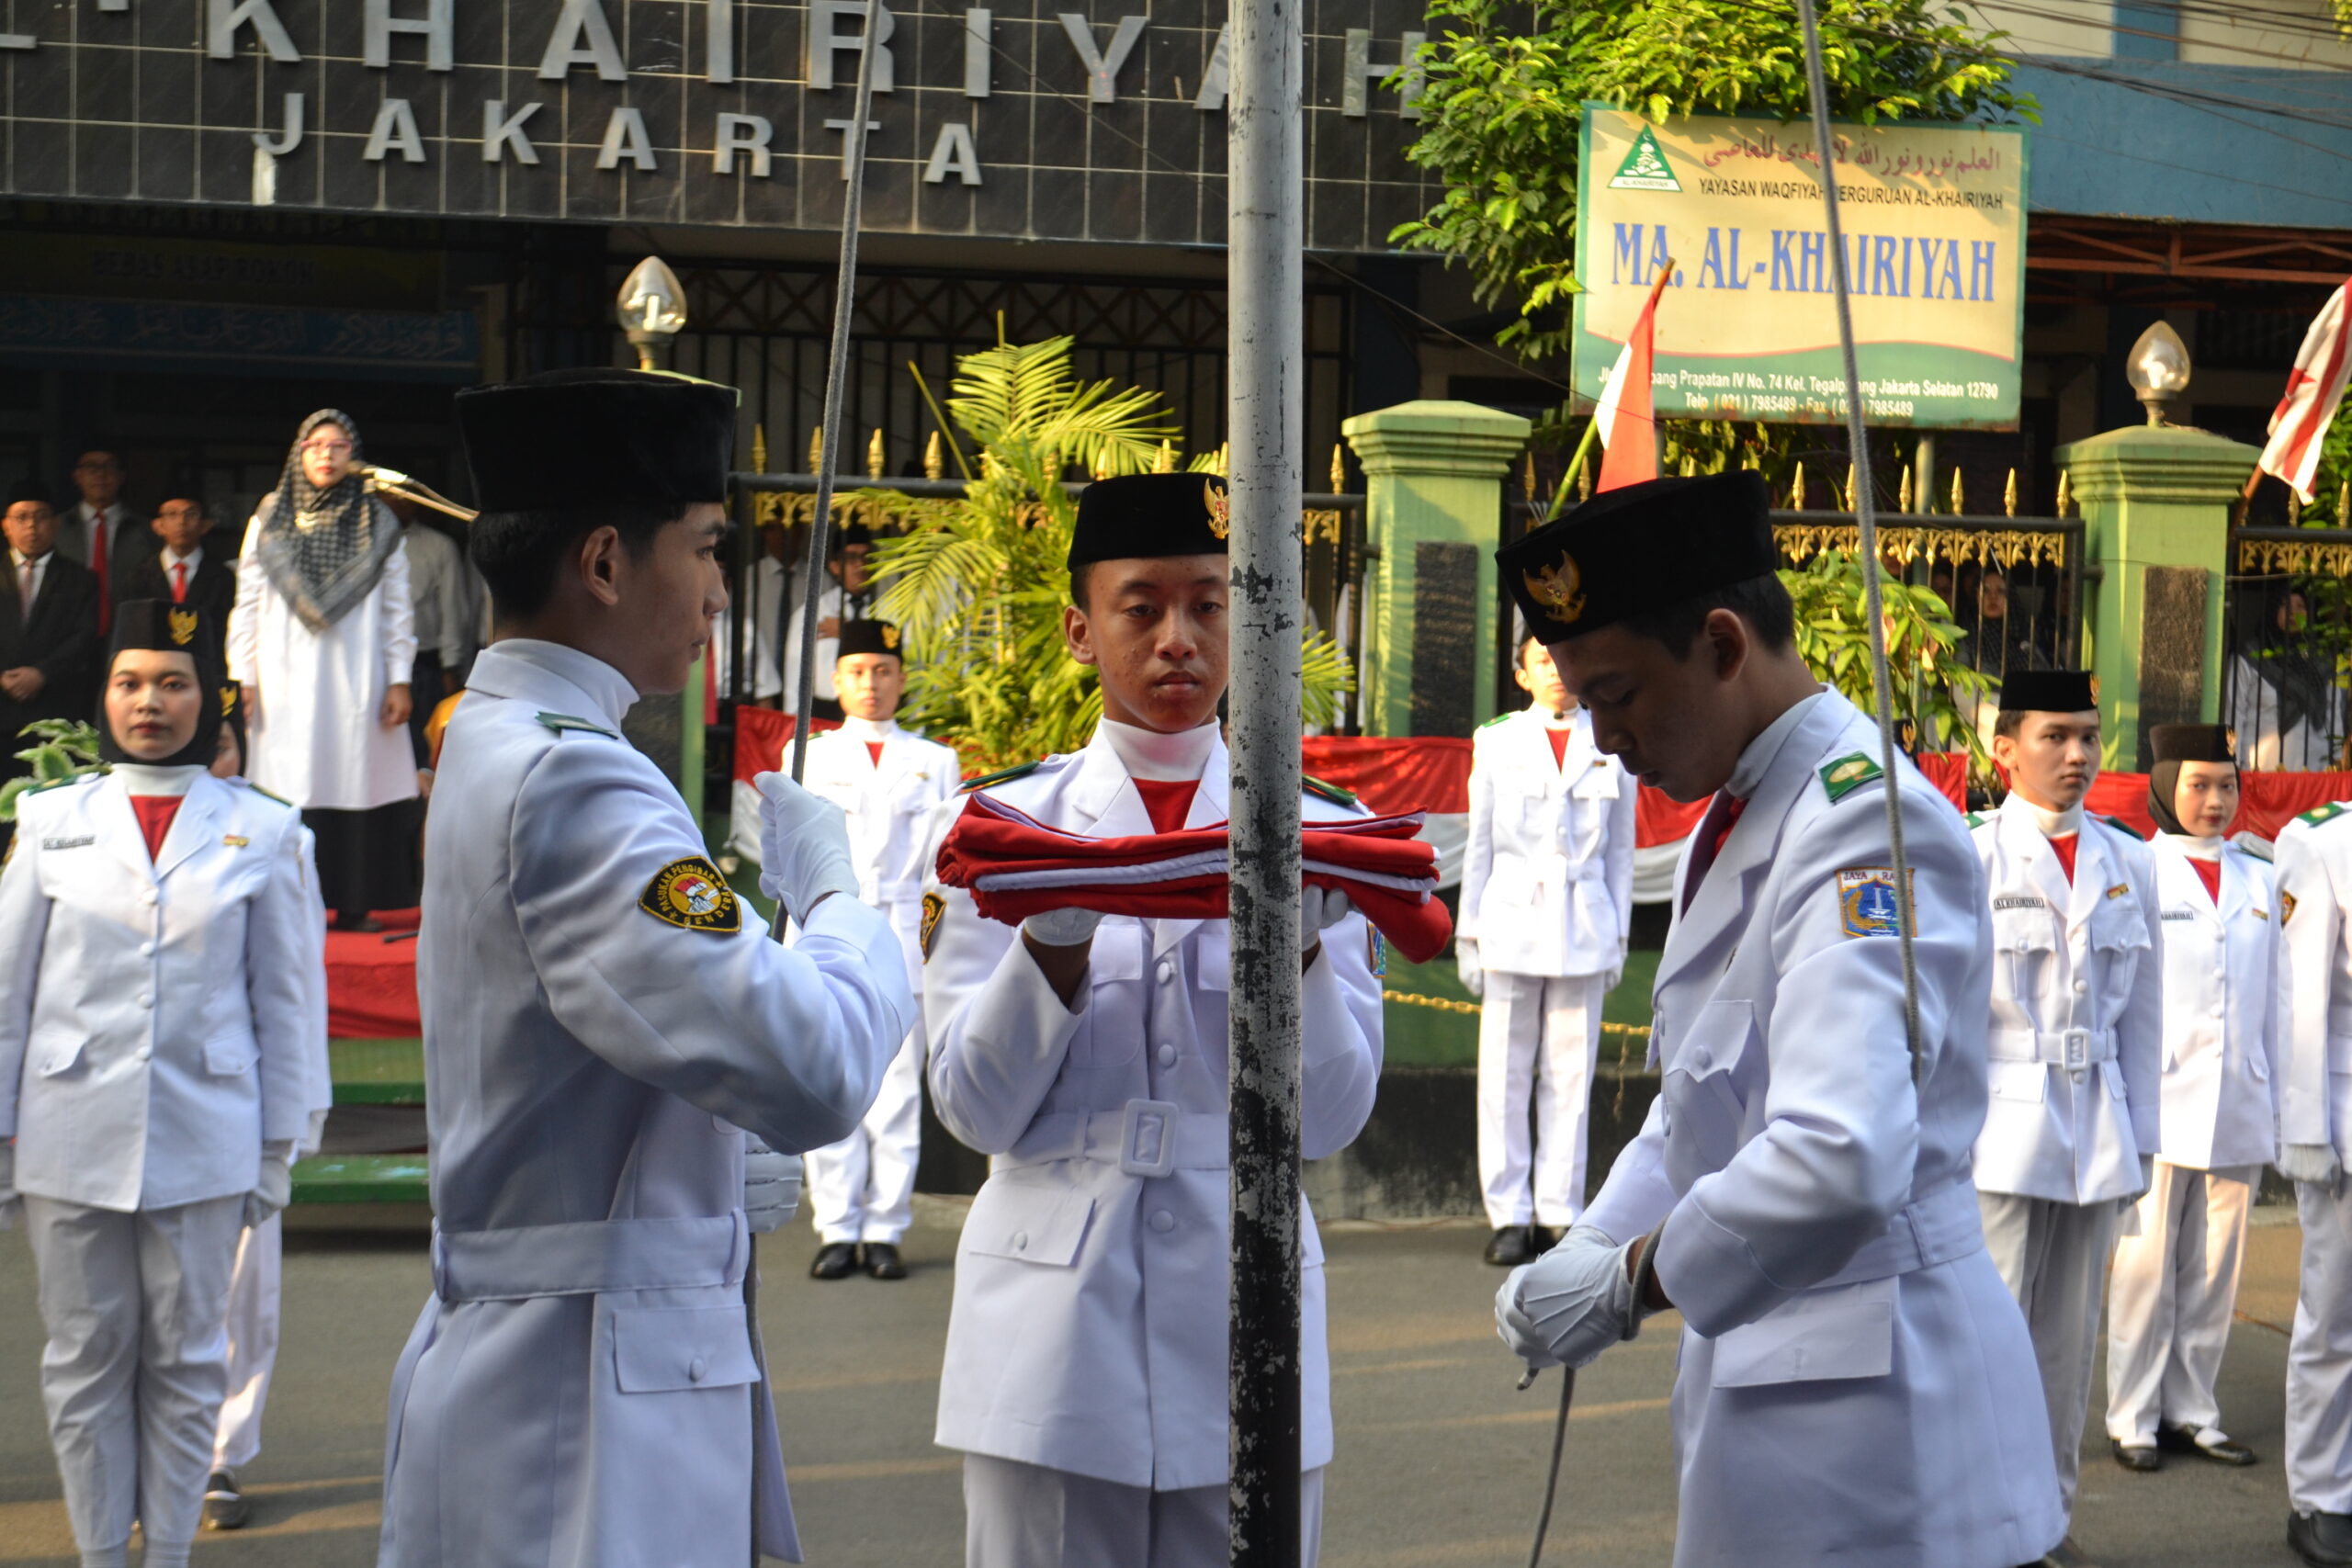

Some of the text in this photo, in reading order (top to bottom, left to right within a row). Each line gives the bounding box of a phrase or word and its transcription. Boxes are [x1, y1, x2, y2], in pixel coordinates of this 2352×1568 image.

[252, 93, 984, 187] JAKARTA
[1699, 177, 1758, 197] YAYASAN
[1838, 185, 1912, 206] ERGURUAN
[1915, 190, 2004, 210] AL-KHAIRIYAH
[1611, 222, 1996, 302] MA. AL-KHAIRIYAH
[1679, 369, 1730, 390] Prapatan
[1732, 371, 1746, 388] IV
[1747, 373, 1767, 389] No.
[1769, 373, 1783, 389] 74
[1784, 375, 1806, 392] Kel.
[1879, 378, 1921, 397] Jakarta
[1922, 379, 1964, 398] Selatan
[1966, 381, 1999, 400] 12790
[1751, 394, 1796, 412] 7985489
[1868, 398, 1915, 418] 7985489
[1843, 872, 1868, 881] JAYA
